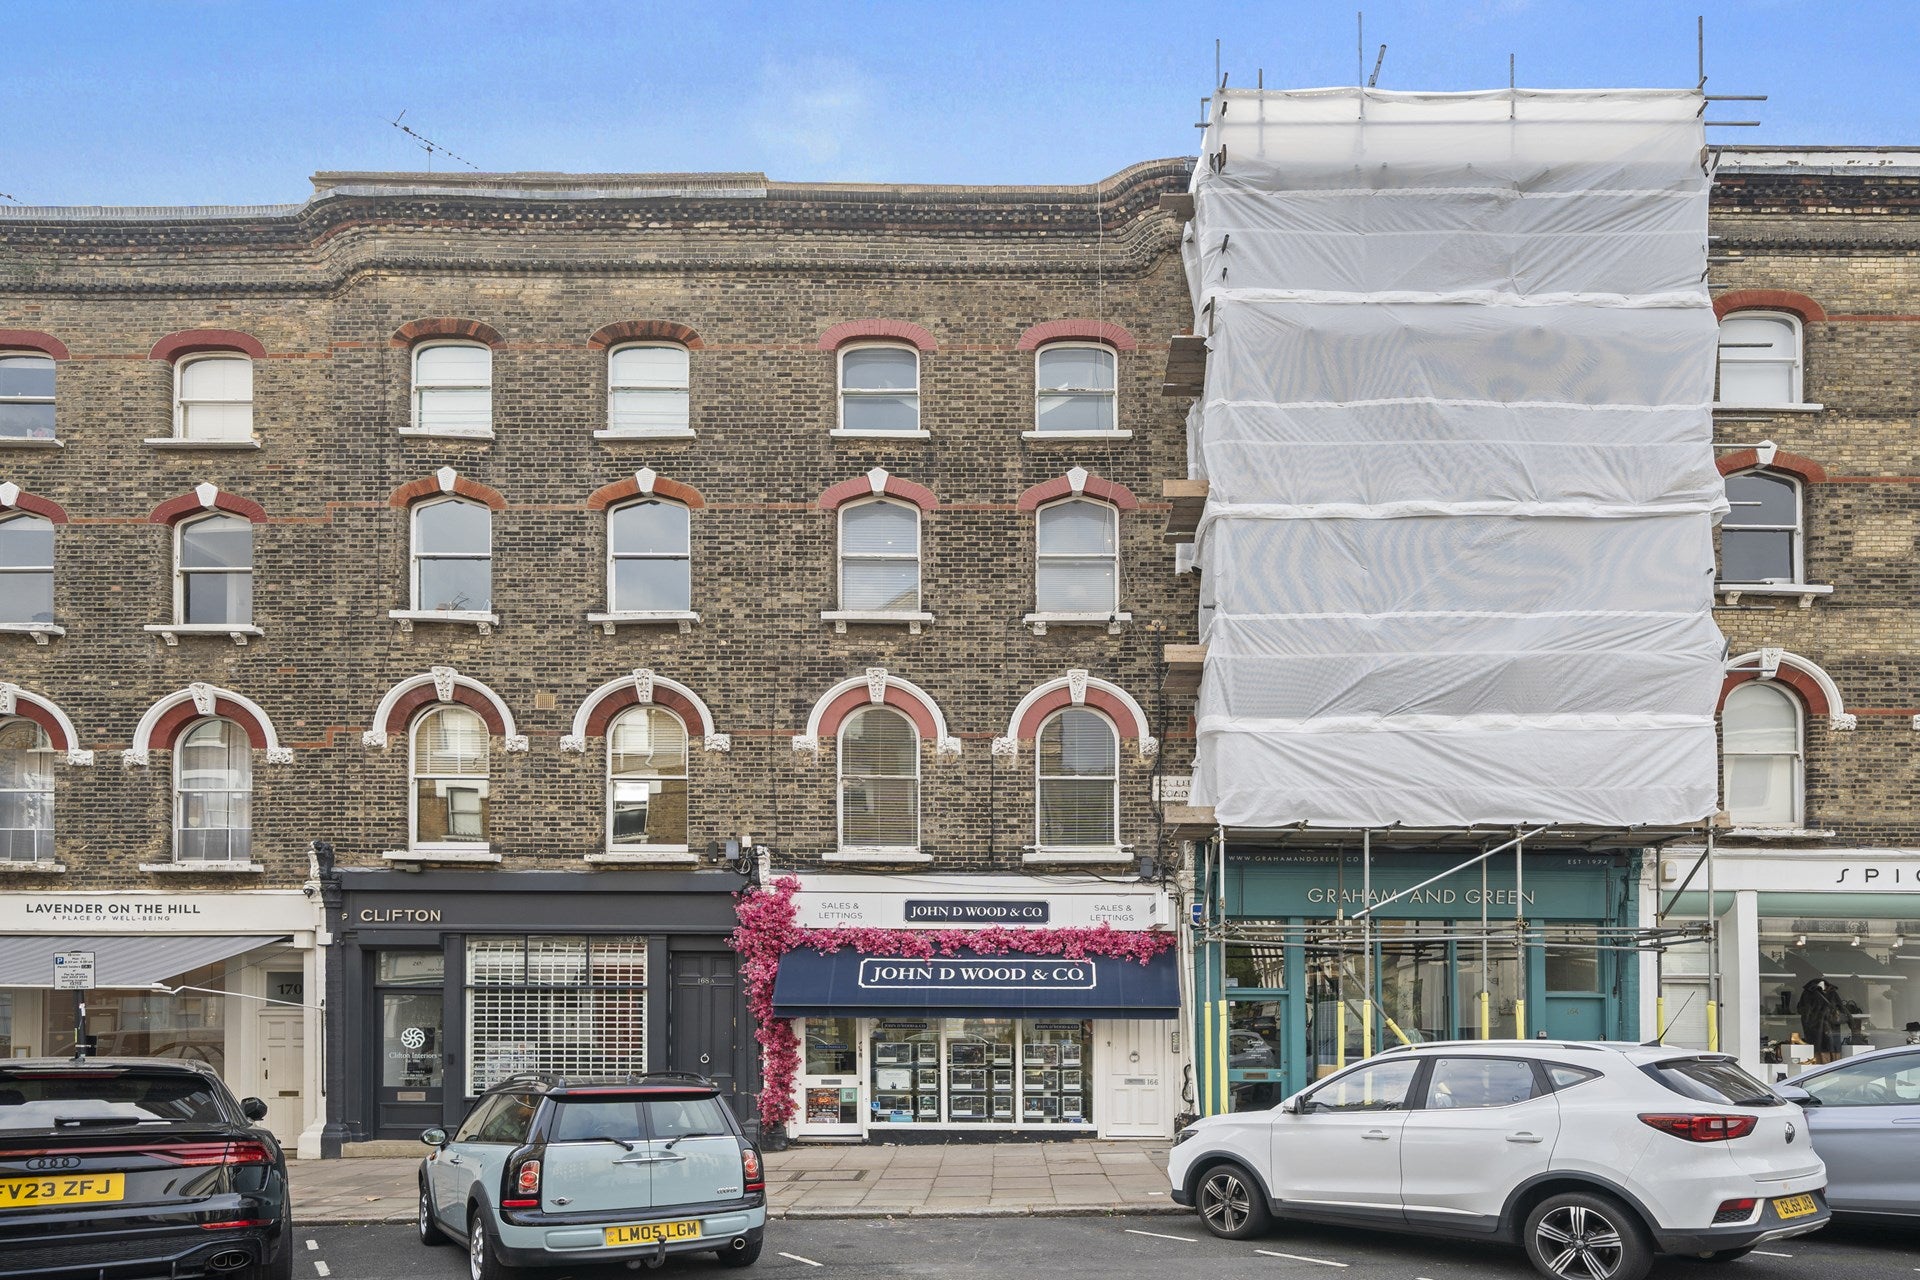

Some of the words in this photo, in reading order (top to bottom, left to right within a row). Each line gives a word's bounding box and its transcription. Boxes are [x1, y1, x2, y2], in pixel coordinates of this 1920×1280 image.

[1307, 888, 1398, 903] GRAHAM
[1409, 889, 1456, 904] AND
[1465, 889, 1535, 905] GREEN
[26, 904, 103, 913] LAVENDER
[108, 904, 130, 913] ON
[135, 904, 163, 913] THE
[168, 904, 201, 914] HILL
[821, 902, 851, 910] SALES
[853, 902, 859, 910] &
[1094, 904, 1124, 912] SALES
[1126, 904, 1132, 912] &
[360, 909, 441, 922] CLIFTON
[818, 912, 863, 920] LETTINGS
[910, 906, 949, 918] JOHN
[953, 906, 963, 917] D
[966, 906, 1007, 917] WOOD
[1010, 907, 1020, 917] &
[1090, 914, 1135, 922] LETTINGS
[870, 967, 934, 982] JOHN
[939, 968, 955, 980] D
[960, 968, 1027, 980] WOOD
[1031, 968, 1049, 981] &
[1052, 968, 1085, 981] CO.
[276, 984, 303, 995] 170
[63, 1180, 111, 1197] ZFJ
[666, 1222, 697, 1238] LGM
